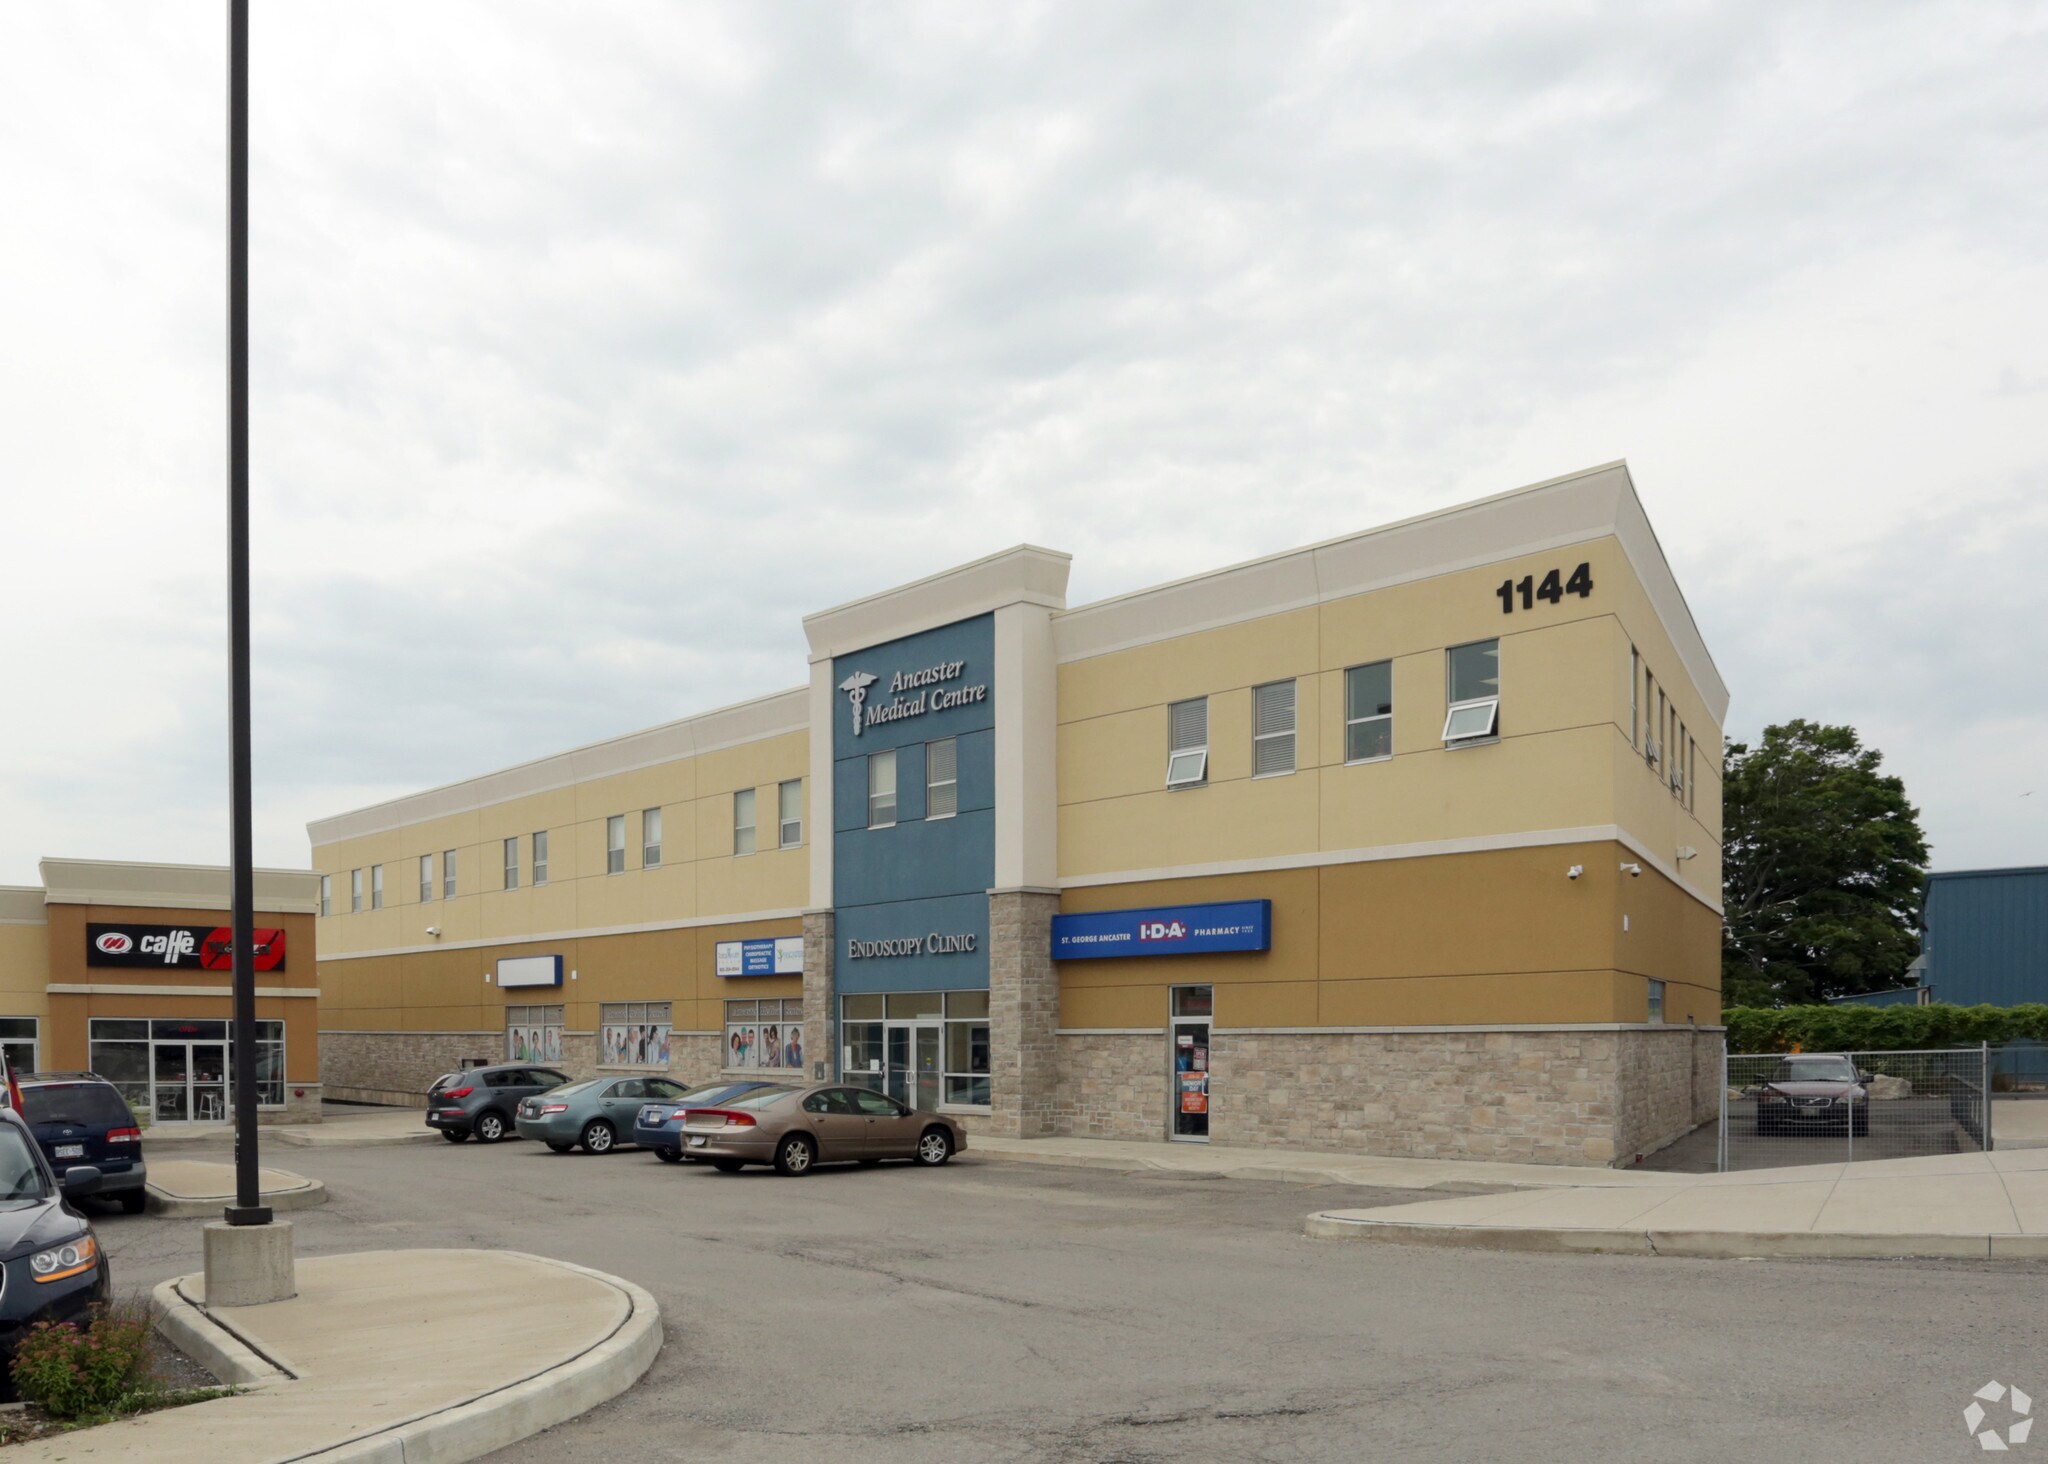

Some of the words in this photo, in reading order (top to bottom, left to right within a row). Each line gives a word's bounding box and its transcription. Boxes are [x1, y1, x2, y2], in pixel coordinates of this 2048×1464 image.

[1496, 562, 1593, 614] 1144
[889, 660, 964, 693] Ancaster
[865, 690, 926, 726] Medical
[930, 684, 986, 711] Centre
[1061, 936, 1071, 944] ST.
[1071, 935, 1098, 944] GEORGE
[1099, 933, 1131, 942] ANCASTER
[1194, 926, 1240, 936] PHARMACY
